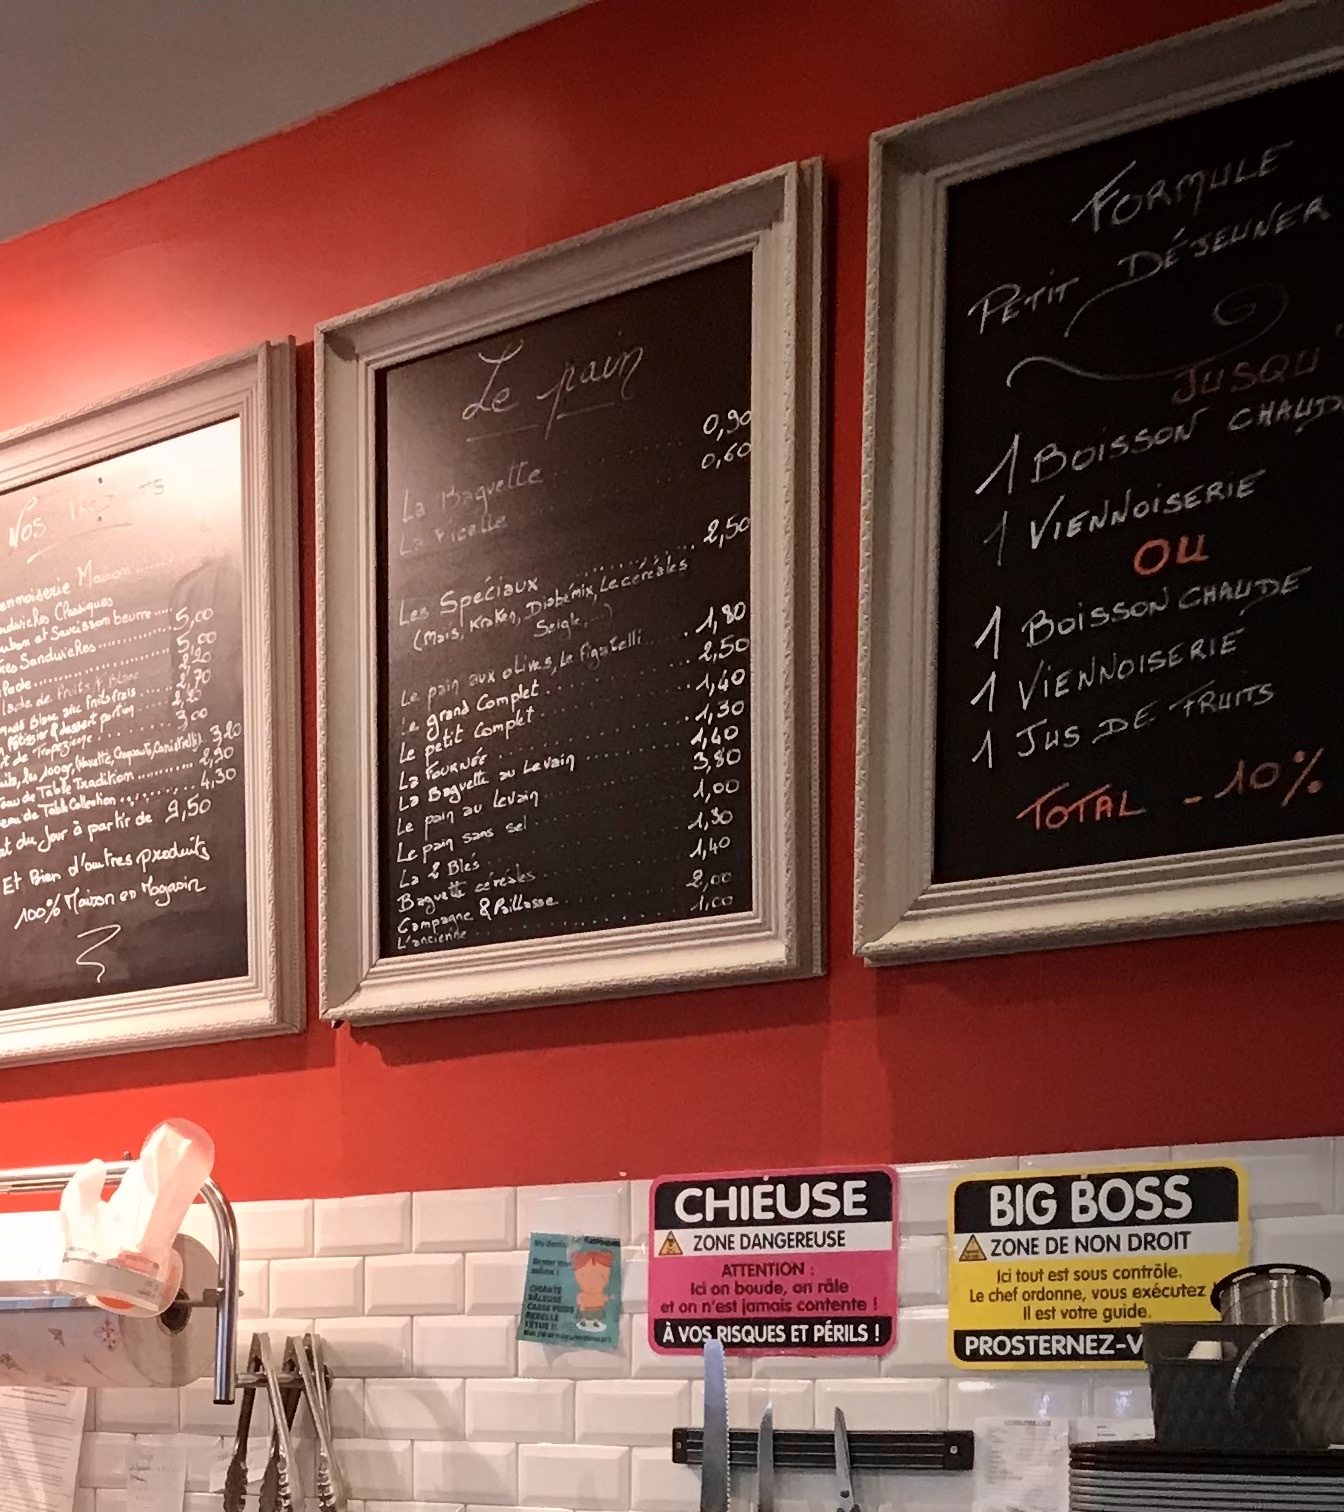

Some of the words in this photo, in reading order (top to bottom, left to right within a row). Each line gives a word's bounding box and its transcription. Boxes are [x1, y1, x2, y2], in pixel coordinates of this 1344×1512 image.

[1072, 140, 1294, 233] FORMULE
[967, 269, 1079, 334] PETIT
[462, 339, 524, 421] Le
[1029, 469, 1266, 549] VIENNOISERIE
[1133, 534, 1210, 576] OU
[1022, 586, 1169, 648] BOISSON
[1179, 566, 1312, 615] CHAUDE
[1019, 627, 1245, 711] VIENNOISERIE
[1017, 719, 1080, 758] JUS
[1092, 700, 1159, 744] DE
[1169, 681, 1276, 718] FRUITS
[400, 742, 415, 763] Le
[424, 724, 464, 767] petit
[397, 818, 414, 836] Le
[425, 811, 454, 841] pain
[463, 804, 482, 816] au
[1016, 782, 1146, 831] TOTAL
[16, 832, 37, 850] du
[88, 810, 132, 842] partir
[135, 811, 153, 826] de
[397, 842, 418, 862] Le
[422, 838, 453, 864] pain
[462, 828, 494, 843] sans
[506, 815, 526, 832] sel
[2, 871, 22, 895] Et
[29, 869, 62, 885] Bien
[68, 848, 133, 877] d'autres
[137, 835, 210, 873] produits
[14, 893, 61, 929] 100%
[65, 887, 115, 915] Maison
[119, 889, 137, 902] en
[674, 1179, 869, 1223] CHIEUSE
[990, 1183, 1058, 1226] BIG
[1071, 1175, 1193, 1223] BOSS
[693, 1232, 735, 1252] ZONE
[740, 1229, 846, 1250] DANGEREUSE
[990, 1237, 1040, 1257] ZONE
[1046, 1237, 1069, 1254] DE
[1075, 1234, 1121, 1253] NON
[1128, 1231, 1191, 1251] DROIT
[691, 1281, 707, 1295] Ici
[711, 1282, 729, 1295] on
[735, 1279, 788, 1296] boude,
[792, 1281, 812, 1294] on
[817, 1279, 849, 1293] râle
[722, 1262, 805, 1278] ATTENTION
[997, 1268, 1012, 1283] Ici
[1016, 1267, 1044, 1282] tout
[1048, 1266, 1069, 1282] est
[1073, 1266, 1108, 1281] sous
[1112, 1263, 1183, 1281] contrôle.
[660, 1301, 674, 1313] et
[678, 1301, 698, 1313] on
[702, 1297, 738, 1313] n'est
[742, 1298, 792, 1315] jamais
[797, 1297, 867, 1312] contente
[969, 1289, 984, 1303] Le
[989, 1288, 1019, 1303] chef
[1022, 1286, 1086, 1304] ordonne,
[1091, 1285, 1128, 1300] vous
[1133, 1283, 1206, 1299] exécutez
[1023, 1305, 1030, 1320] Il
[1034, 1306, 1056, 1320] est
[1060, 1305, 1098, 1319] votre
[1103, 1304, 1152, 1324] guide.
[663, 1322, 674, 1342] À
[678, 1324, 712, 1343] VOS
[717, 1324, 786, 1343] RISQUES
[790, 1324, 808, 1342] ET
[813, 1319, 868, 1342] PÉRILS
